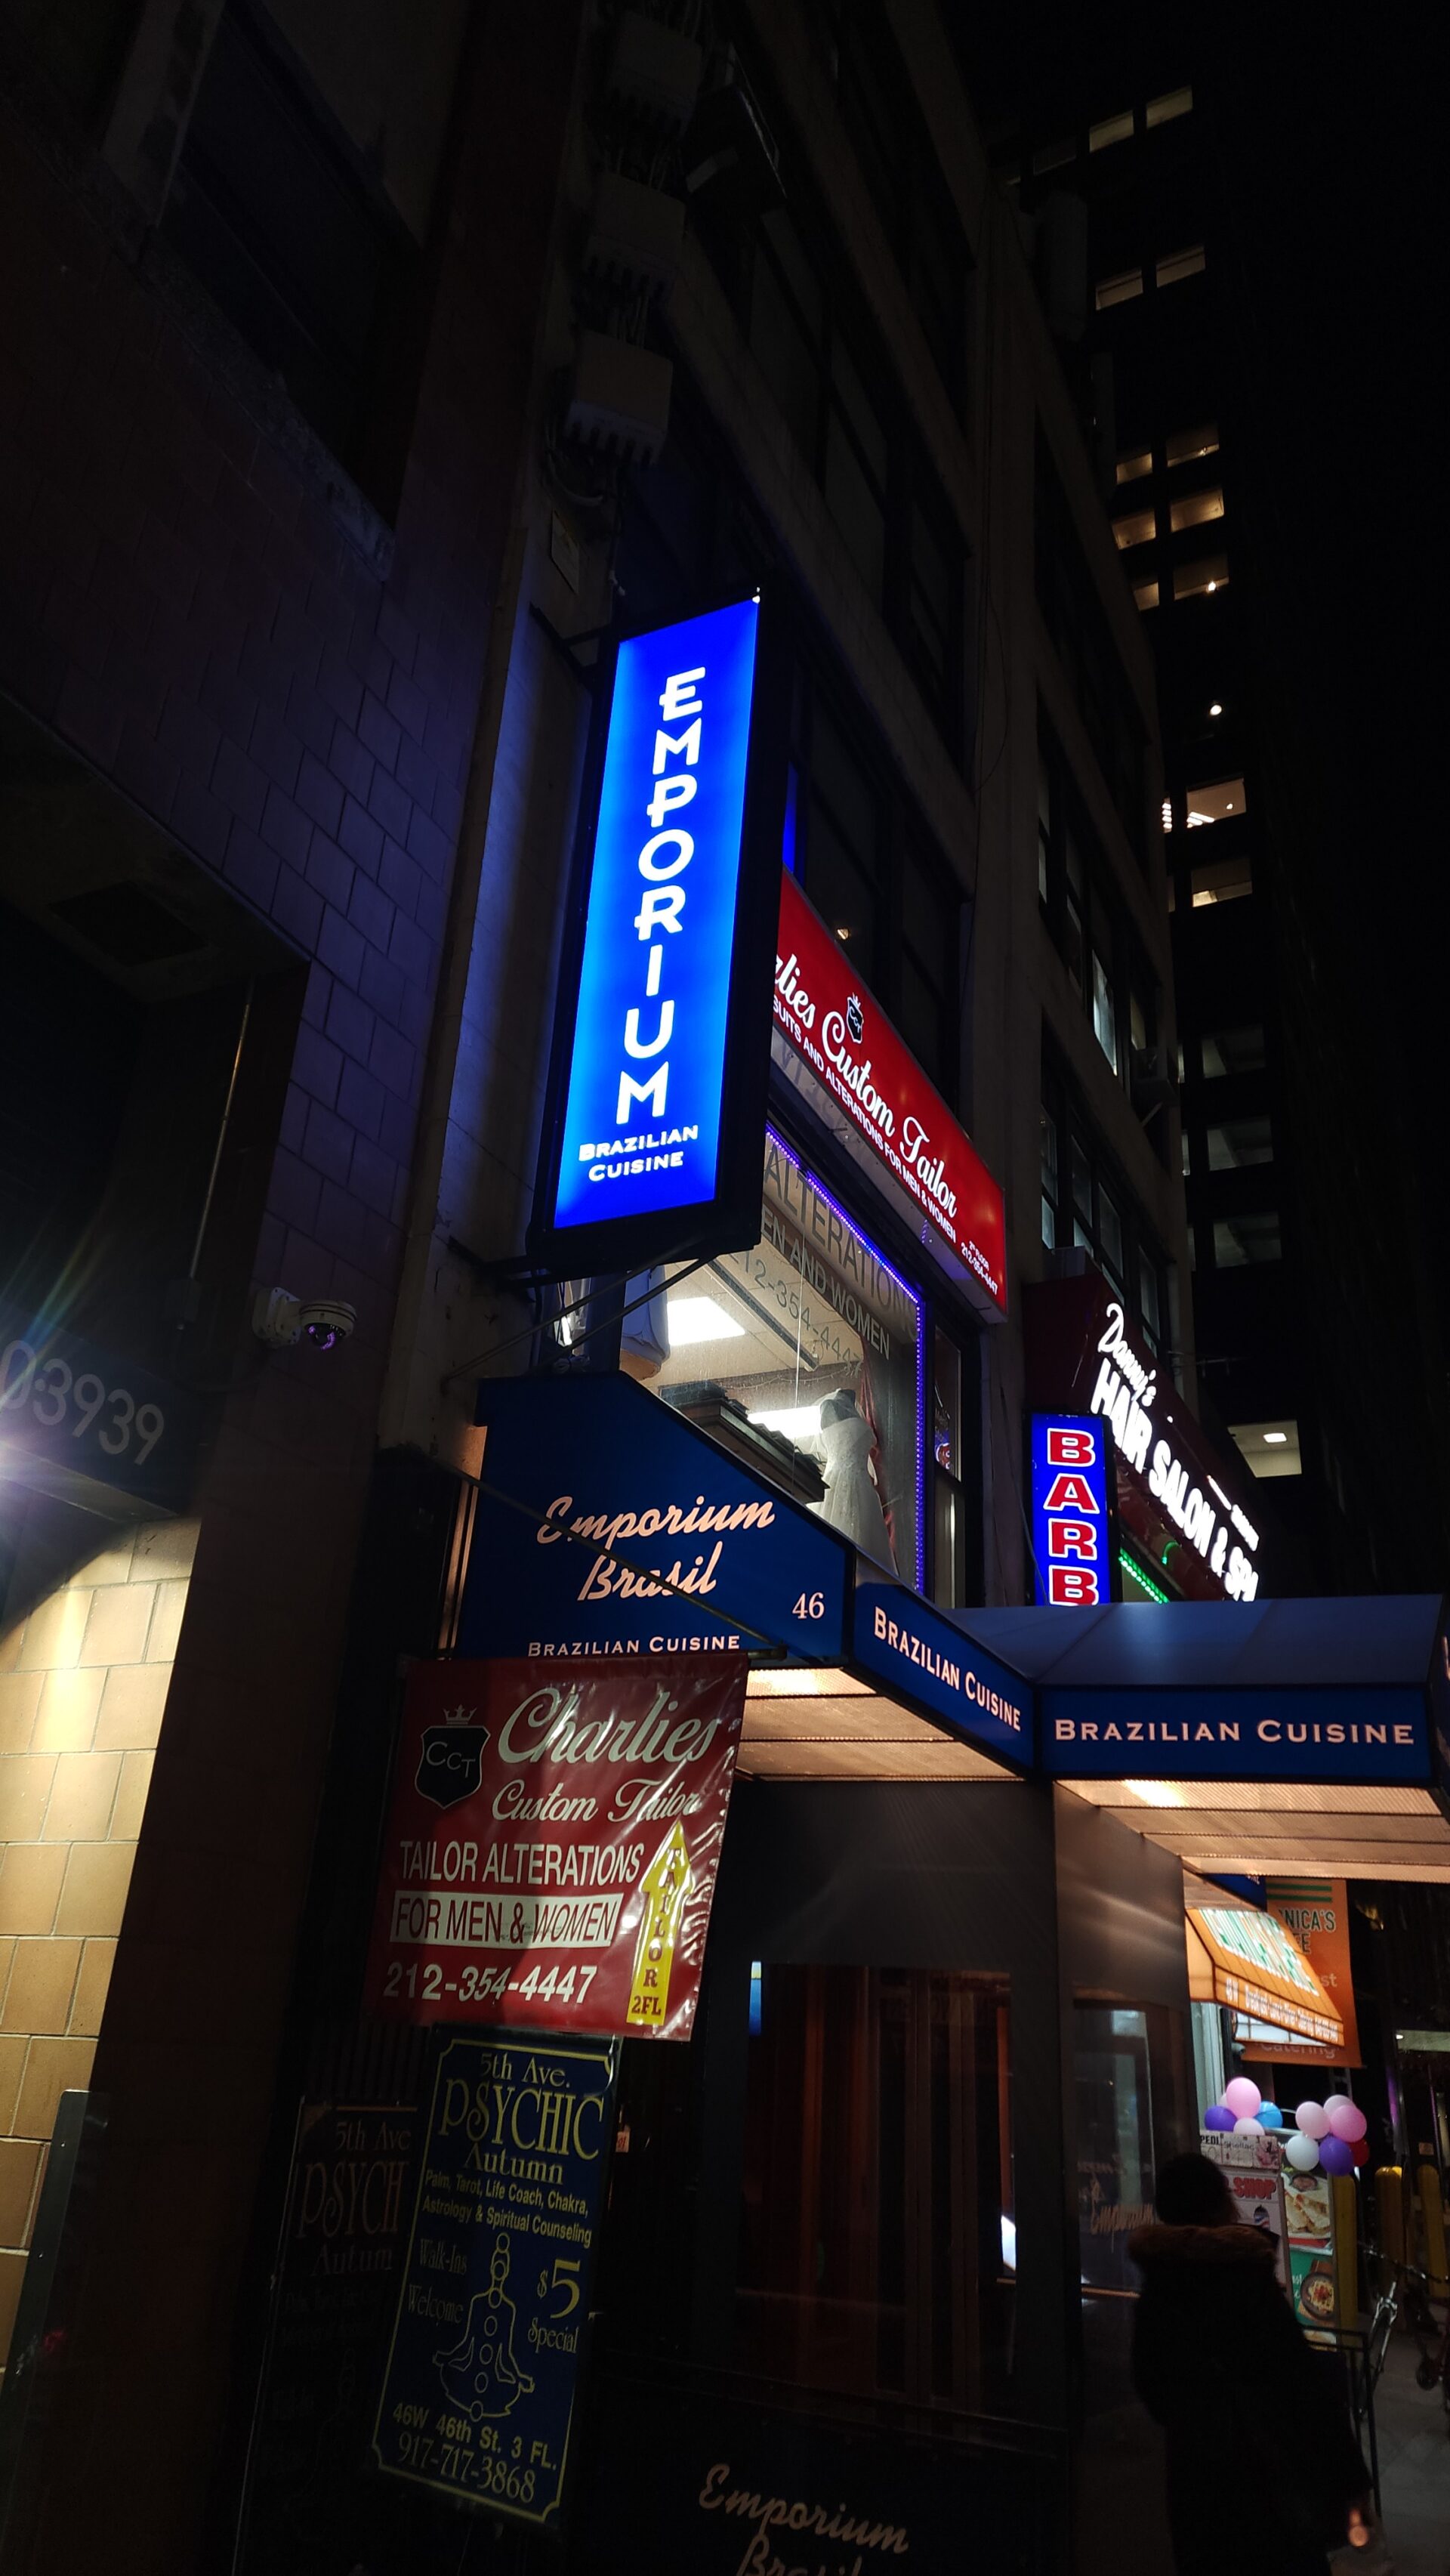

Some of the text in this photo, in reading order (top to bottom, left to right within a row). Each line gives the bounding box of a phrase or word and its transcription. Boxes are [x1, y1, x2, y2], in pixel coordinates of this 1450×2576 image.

[615, 667, 705, 1125] EMPORIUM
[773, 994, 802, 1043] SUITS
[804, 1036, 824, 1072] AND
[826, 1066, 883, 1151] ALTERATIONS
[884, 1141, 903, 1174] FOR
[902, 1165, 921, 1199] MEN
[927, 1196, 956, 1243] WOMEN
[822, 1011, 896, 1137] Custom
[899, 1117, 957, 1218] Tailor
[578, 1125, 699, 1161] BRAZILIAN
[588, 1151, 683, 1181] CUISINE
[760, 1207, 890, 1360] EN AND WOMEN
[730, 1251, 862, 1377] 12-354-4447
[1091, 1357, 1152, 1474] HAIR
[1149, 1439, 1216, 1558] SALON
[537, 1496, 775, 1550] Emporium
[1044, 1428, 1100, 1606] BARB
[577, 1540, 723, 1601] Brasil
[792, 1592, 825, 1619] 46
[529, 1635, 740, 1657] BRAZILIAN CUISINE
[875, 1606, 1021, 1732] BRAZILIAN CUISINE
[498, 1688, 722, 1764] Charlies
[1055, 1719, 1415, 1745] BRAZILIAN CUISINE
[492, 1778, 703, 1823] Custom Tailor
[400, 1841, 645, 1886] TAILOR ALTERATIONS
[396, 1898, 620, 1944] FOR MEN & WOMEN
[643, 1848, 681, 1988] TAILOR
[1280, 1909, 1336, 1932] NICA'S
[383, 1963, 597, 2004] 212-354-4447
[631, 1996, 662, 2016] 2FL
[480, 2052, 570, 2089] 5th Ave.
[438, 2078, 604, 2161] PSYCHIC
[462, 2141, 564, 2185] Autumn
[1233, 2177, 1276, 2200] SHOP
[424, 2169, 589, 2218] Palm, Tarot, Life Coach, Chakra,
[422, 2195, 592, 2249] Astrology & Spiritual Counseling
[408, 2284, 464, 2324] Welcome
[528, 2318, 579, 2353] Special
[393, 2402, 556, 2471] 46W 46th St. 3 FL.
[399, 2431, 536, 2503] 917-717-3868
[699, 2463, 909, 2554] Emporium
